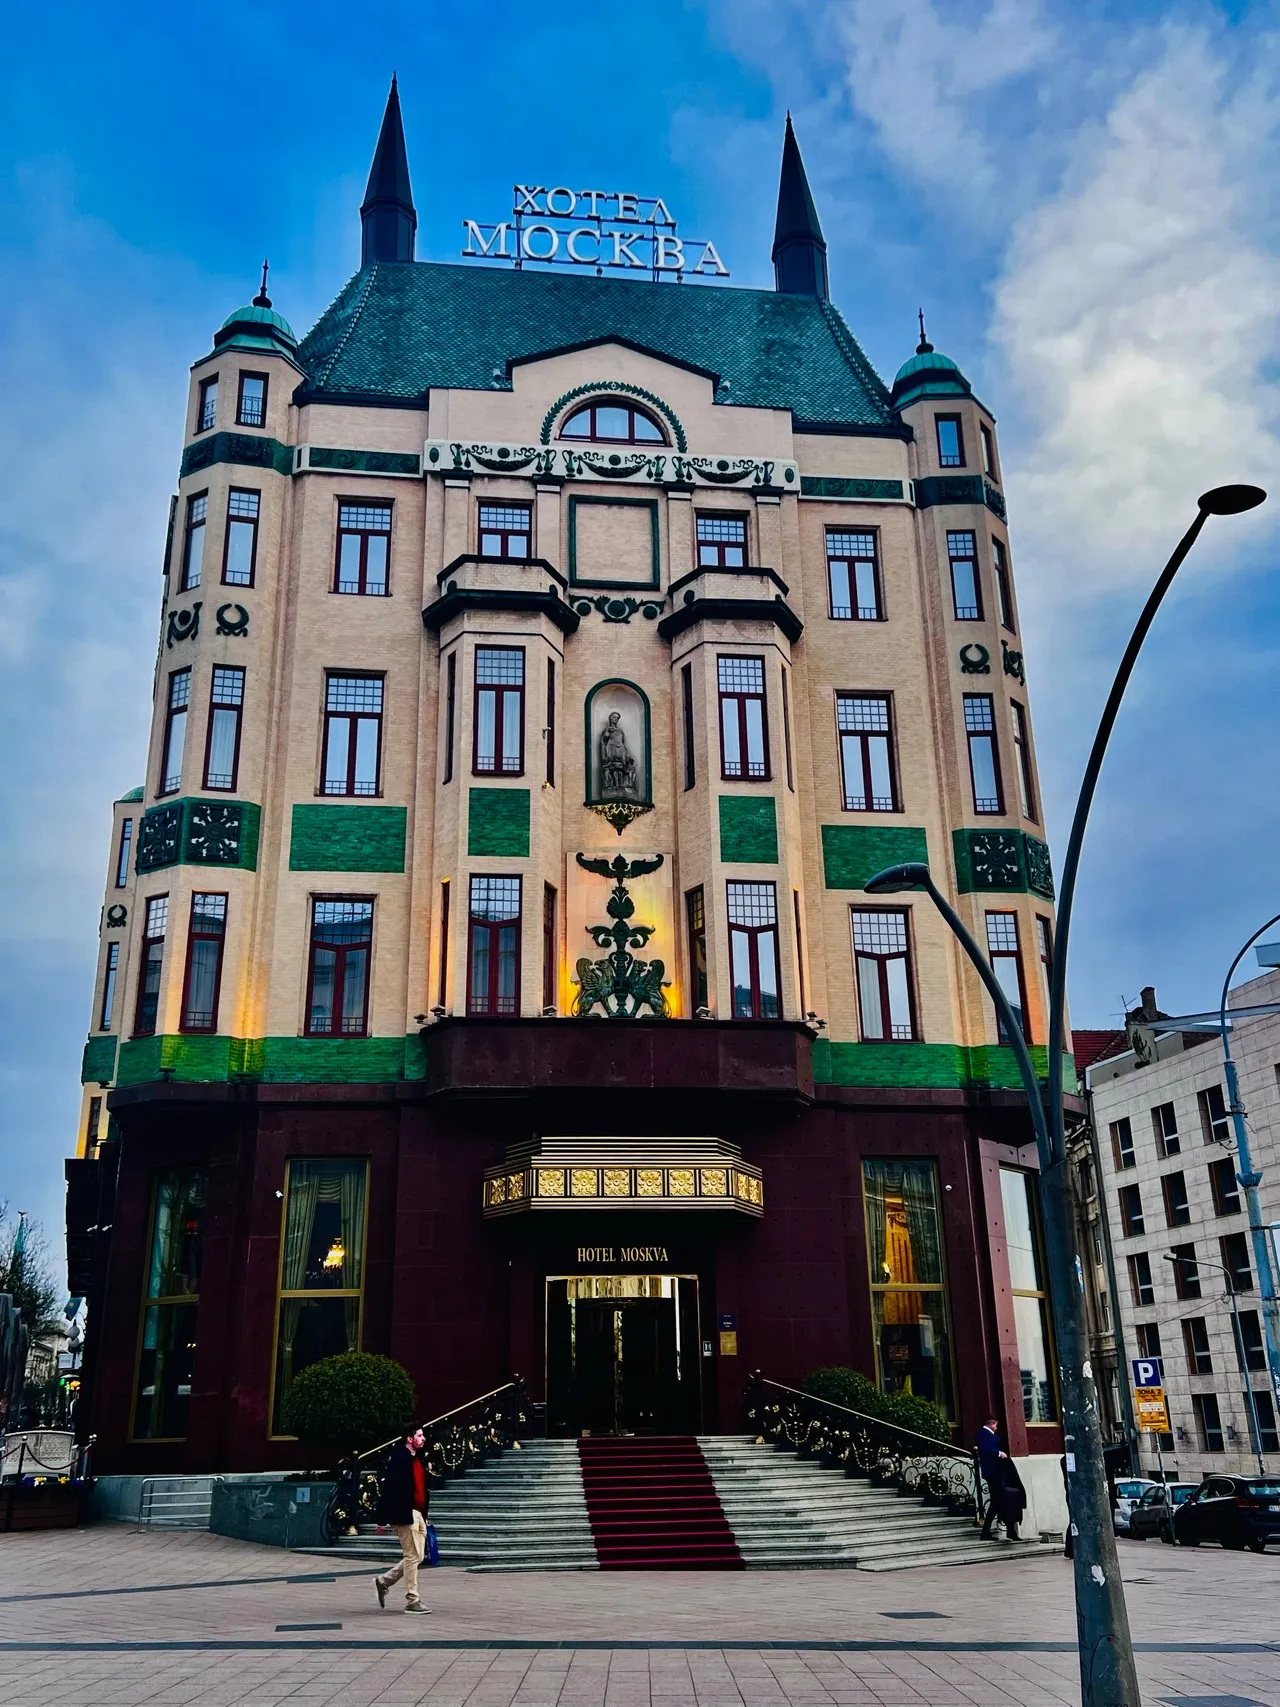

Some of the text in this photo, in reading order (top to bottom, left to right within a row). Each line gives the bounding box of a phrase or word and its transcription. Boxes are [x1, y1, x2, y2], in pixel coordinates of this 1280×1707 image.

[513, 184, 677, 227] ХОТЕЛ
[462, 219, 731, 277] МОСКВА
[577, 1247, 669, 1262] HOTEL MOSKVA
[1138, 1363, 1154, 1384] P
